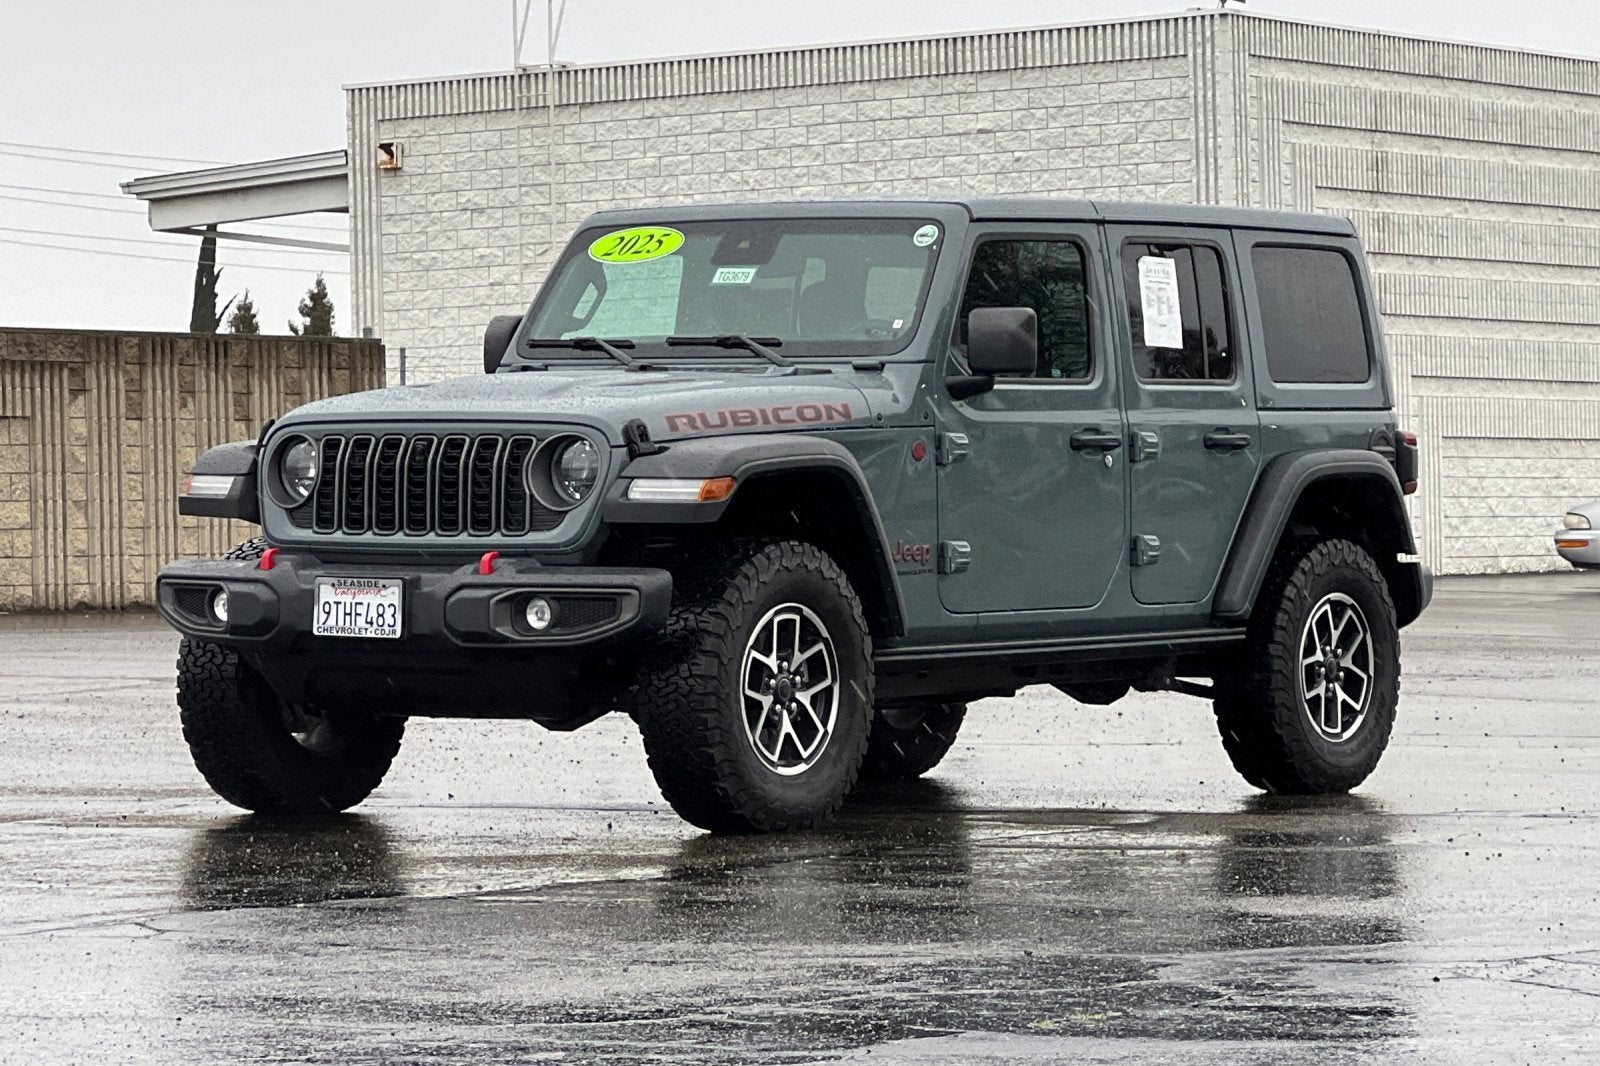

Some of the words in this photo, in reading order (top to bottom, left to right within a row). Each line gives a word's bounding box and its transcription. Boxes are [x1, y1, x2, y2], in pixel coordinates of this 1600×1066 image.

[601, 233, 671, 257] 2025
[717, 271, 750, 282] TG3679
[664, 403, 853, 432] RUBICON
[893, 540, 931, 566] Jeep
[336, 580, 380, 588] SEASIDE
[322, 601, 397, 628] 9THF483
[316, 626, 369, 635] CHEVROLET
[374, 628, 397, 636] CDJR
